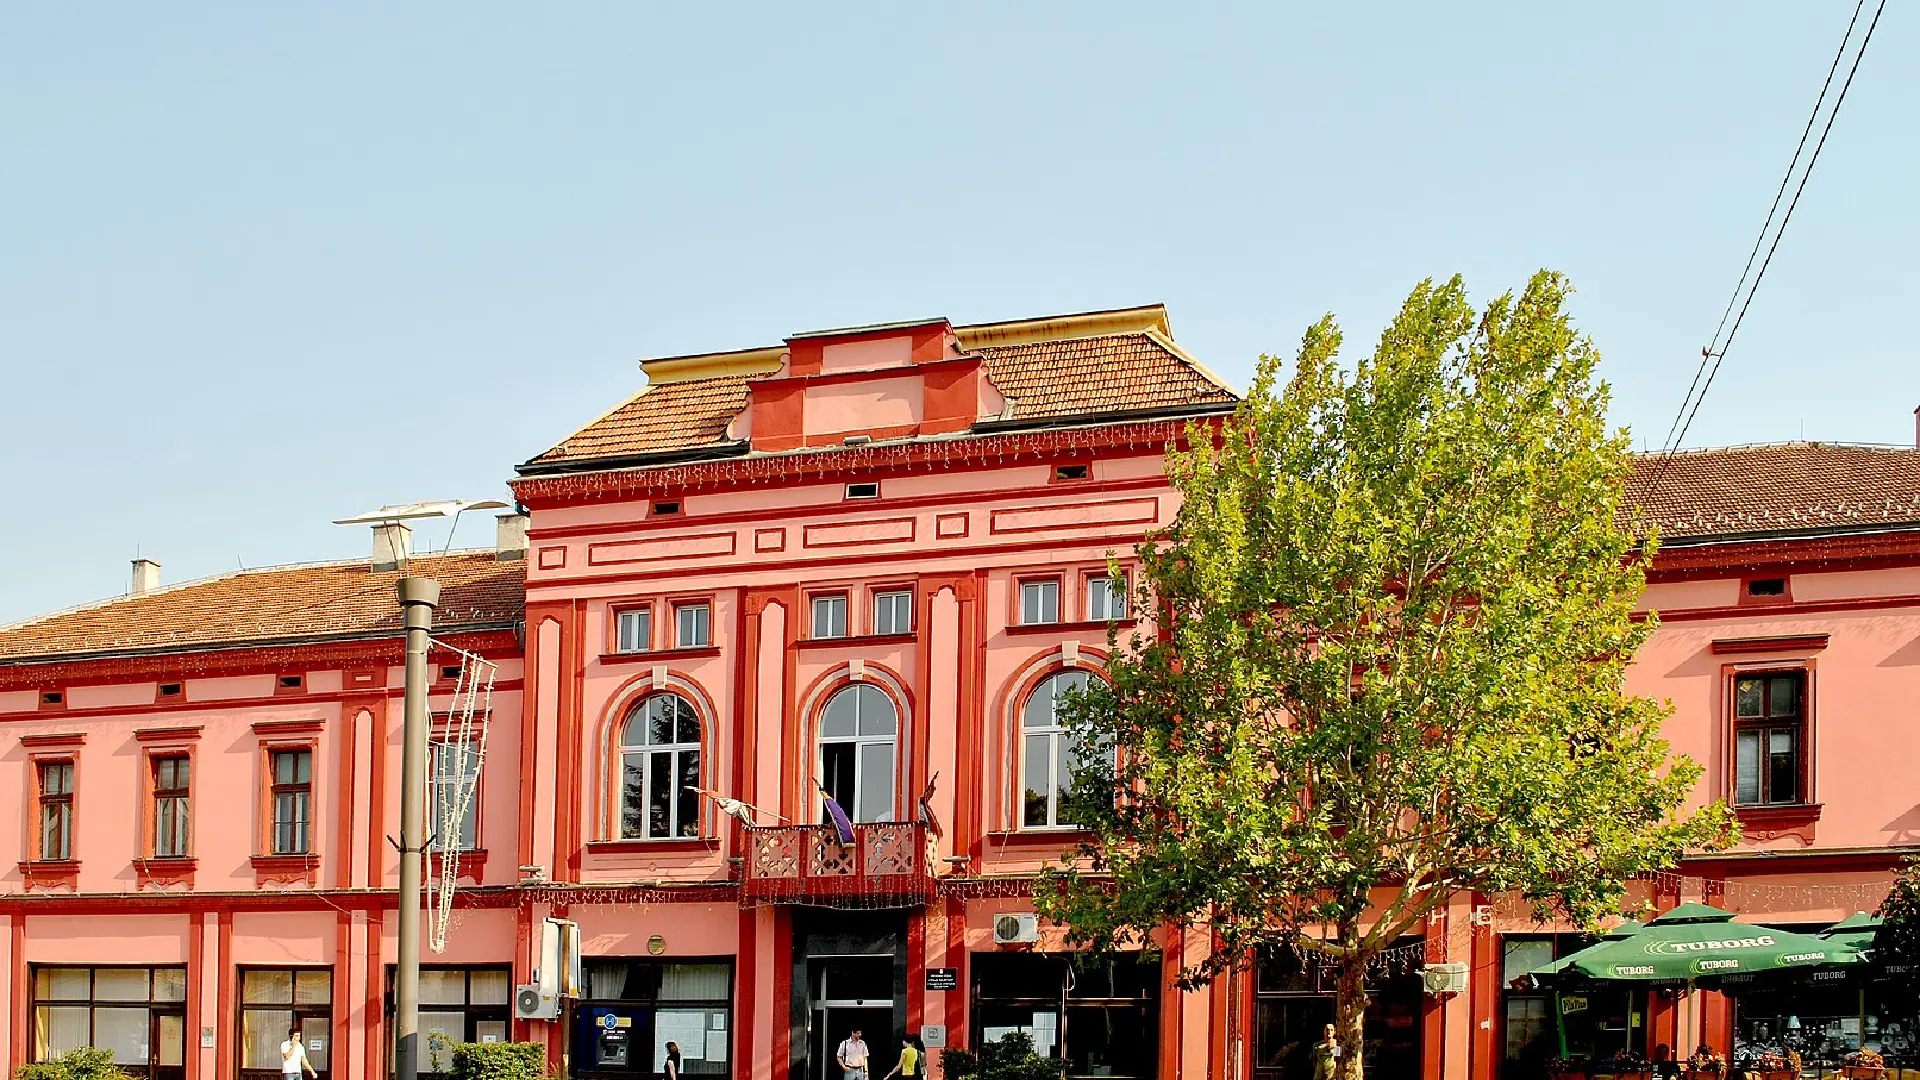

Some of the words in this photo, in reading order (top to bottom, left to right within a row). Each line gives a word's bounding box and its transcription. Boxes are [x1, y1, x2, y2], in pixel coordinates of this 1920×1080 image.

[1670, 936, 1775, 952] TUBORG
[1784, 952, 1825, 962] TUBORG
[1700, 960, 1738, 970] TUBORG
[1616, 966, 1654, 975] TUBORG
[1813, 970, 1846, 981] TUBORG
